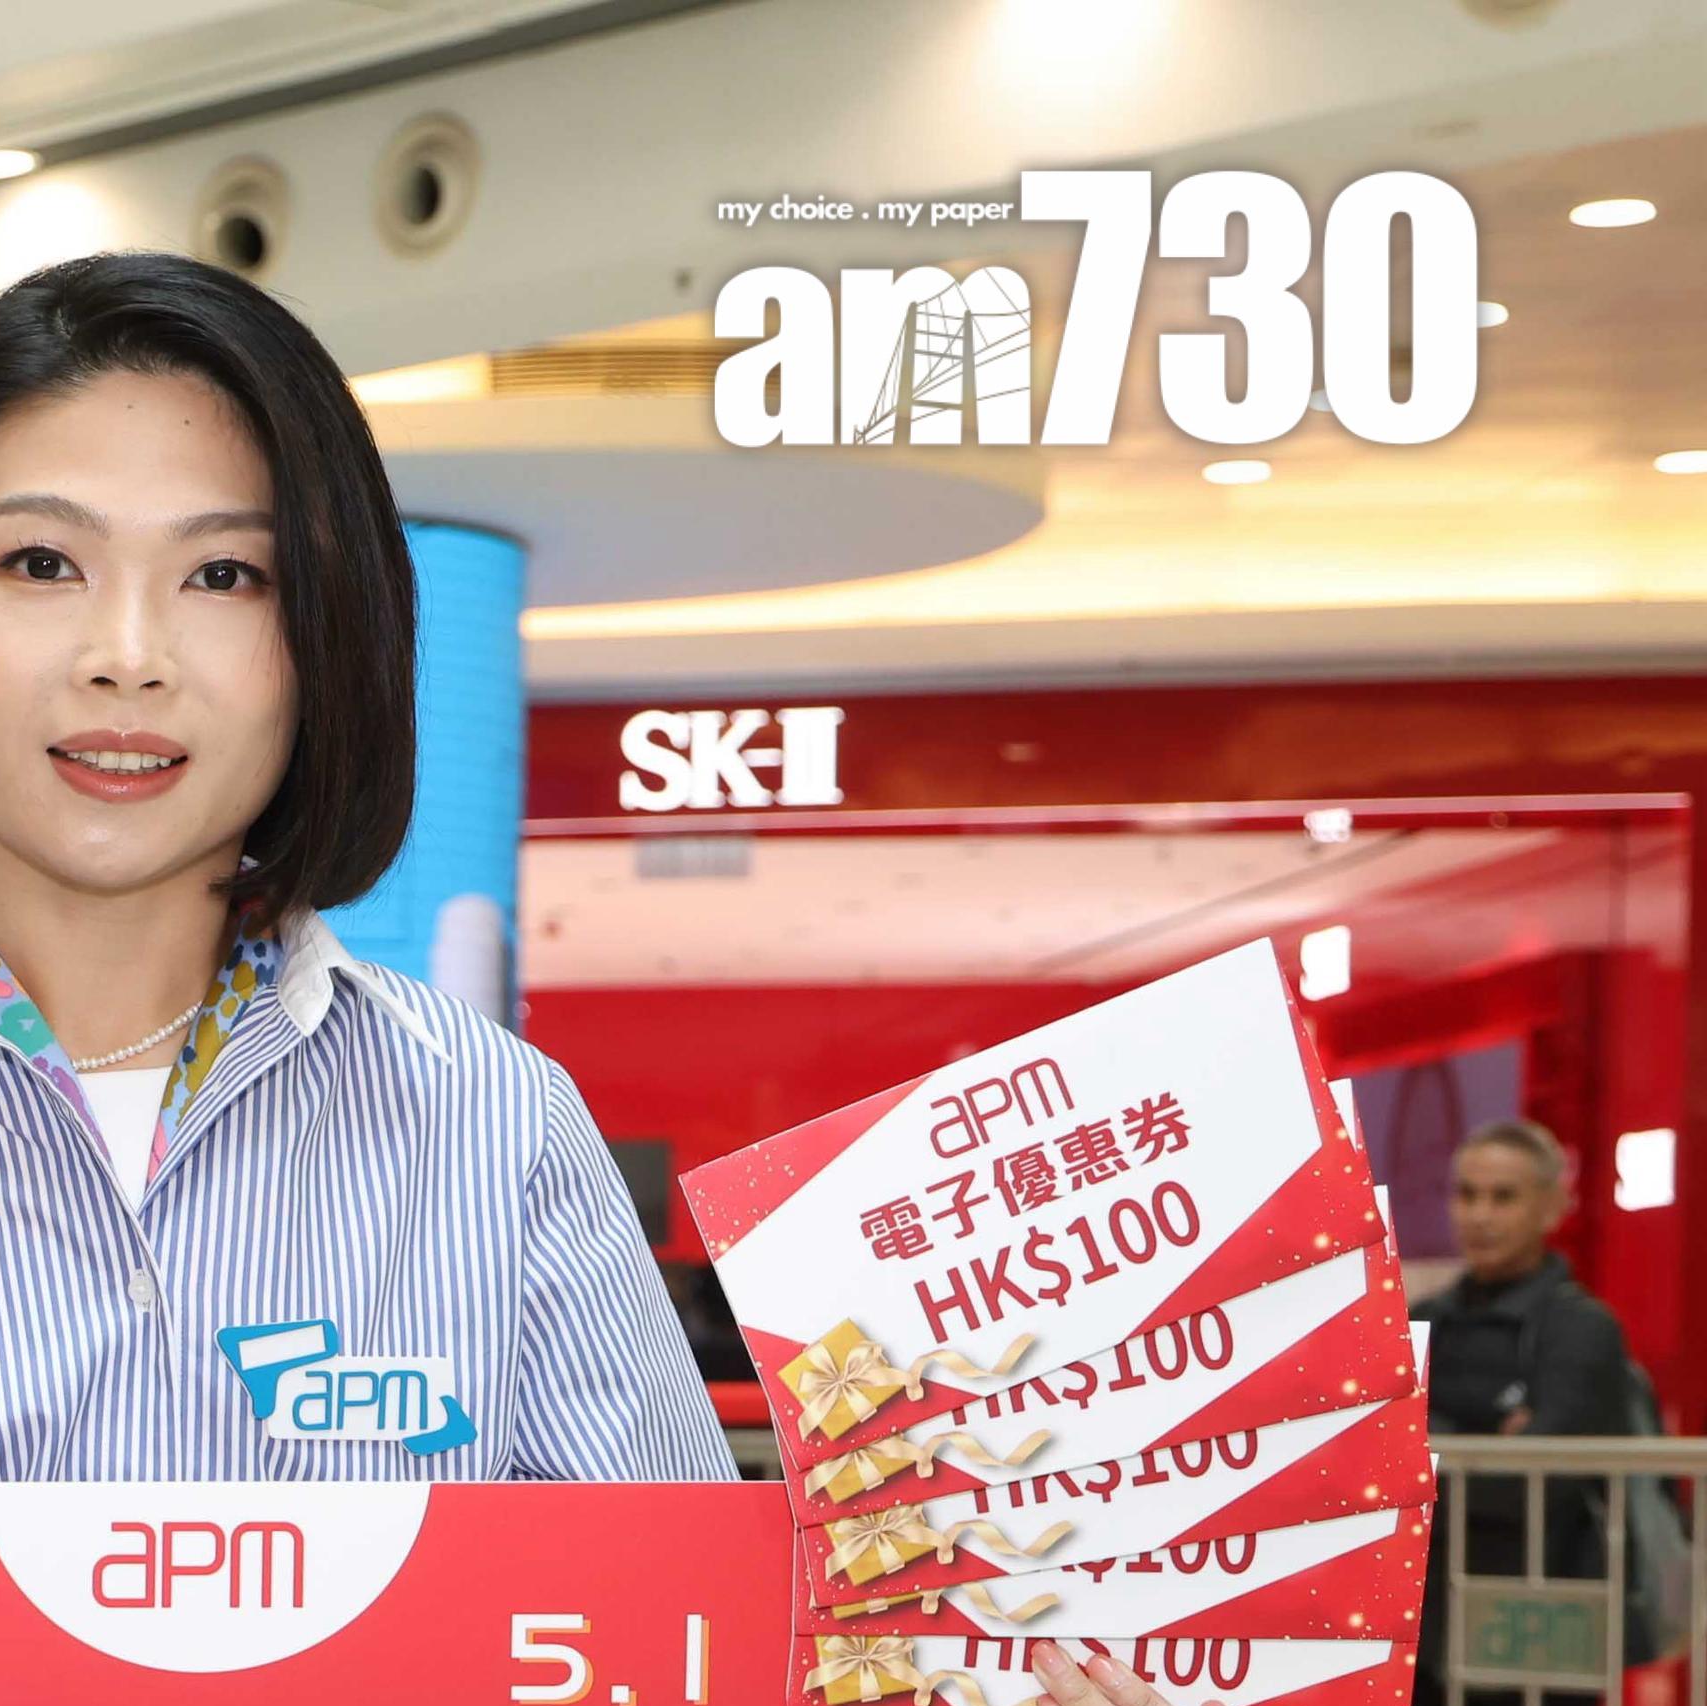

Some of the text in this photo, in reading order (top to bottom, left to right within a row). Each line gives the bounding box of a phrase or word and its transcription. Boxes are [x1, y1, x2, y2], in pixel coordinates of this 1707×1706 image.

[929, 1056, 1075, 1160] apm
[858, 1092, 1192, 1263] 電子優惠券
[912, 1179, 1202, 1344] HK$100
[292, 1370, 429, 1432] apm
[91, 1519, 305, 1609] apm
